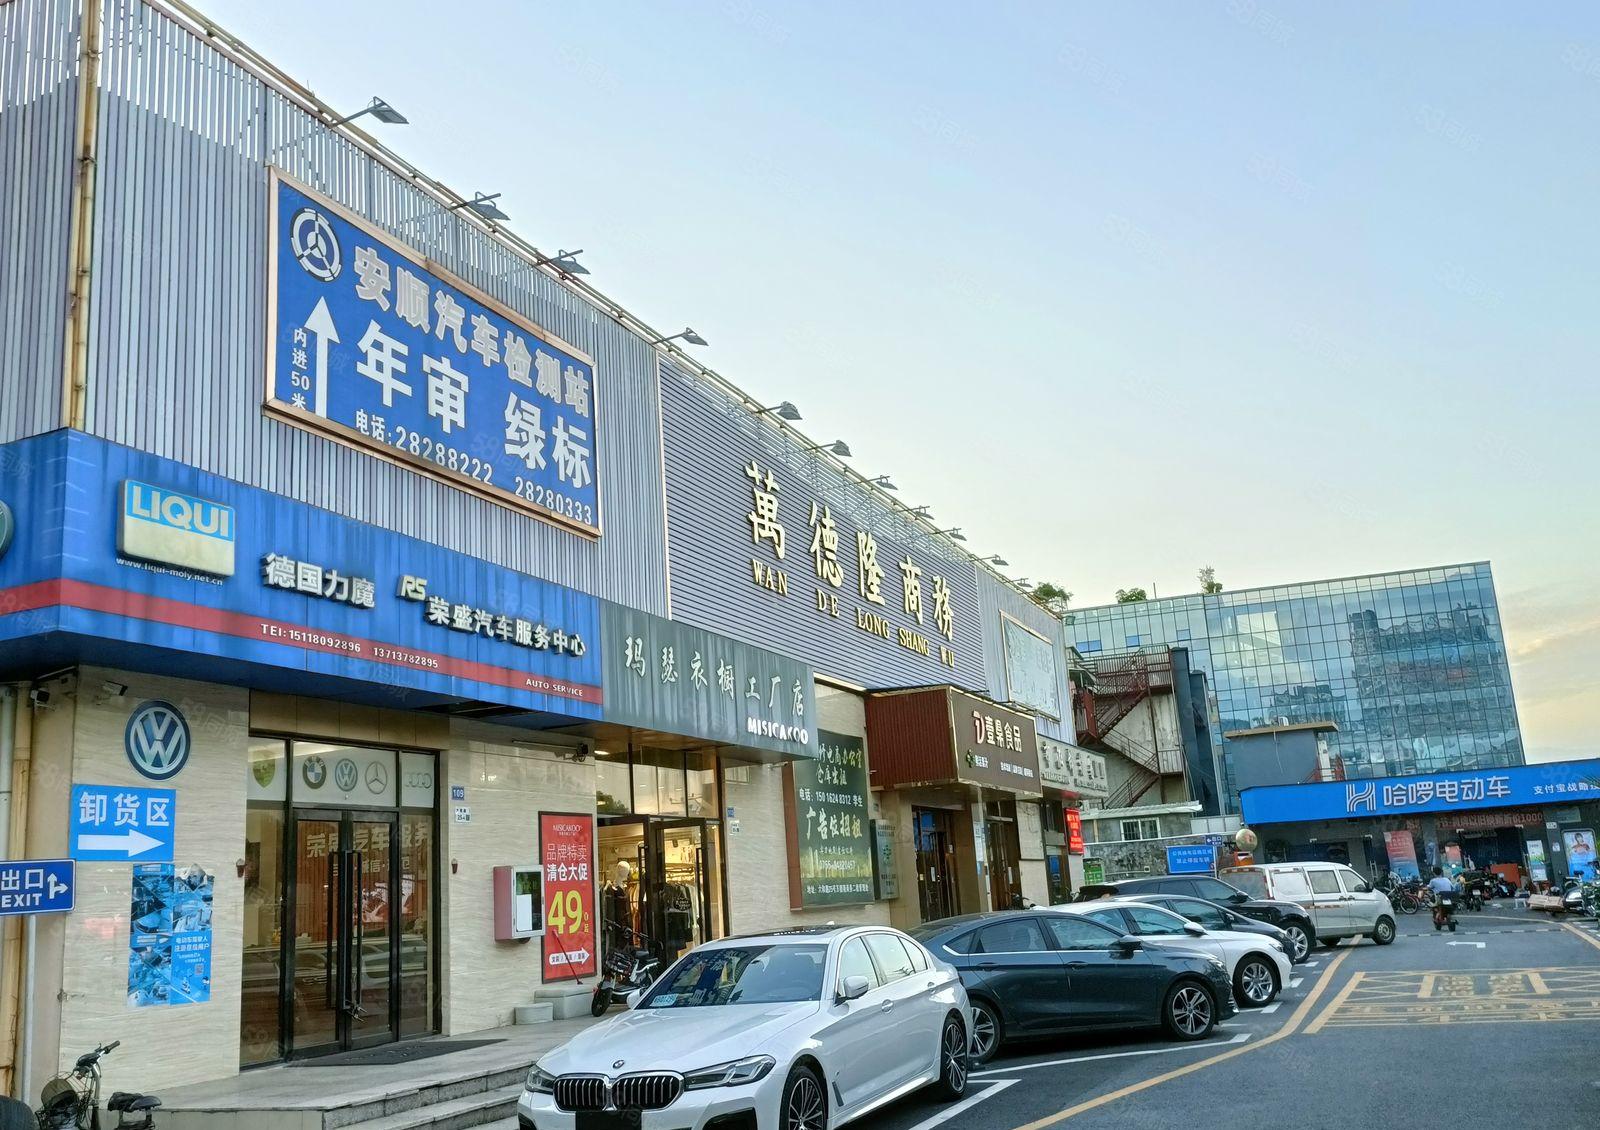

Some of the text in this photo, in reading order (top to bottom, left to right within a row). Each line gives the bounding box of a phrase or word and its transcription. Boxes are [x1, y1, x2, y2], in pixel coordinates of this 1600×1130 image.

[354, 246, 589, 418] 安顺汽车检测站
[357, 320, 591, 488] 年审 绿标
[132, 485, 229, 537] LIQUI
[515, 477, 592, 526] 28280333
[744, 460, 954, 642] 萬德隆商務
[261, 553, 375, 608] 德国力魔
[428, 596, 586, 656] 荣盛汽车服务中心
[752, 558, 955, 668] WAN DE LONG SHANG WU
[373, 647, 438, 669] 13713782895
[624, 636, 804, 717] 玛瑟衣橱工厂店
[526, 678, 583, 697] AUTO SERVICE
[747, 717, 809, 746] MISICAKOO
[79, 791, 170, 827] 卸货区
[1383, 775, 1511, 807] 哈啰电动车
[806, 806, 863, 841] 广告位招租
[546, 843, 587, 861] 品牌特卖
[547, 862, 588, 882] 清仓大促
[1, 868, 44, 891] 出口
[1, 893, 43, 908] EXIT
[547, 889, 583, 935] 49
